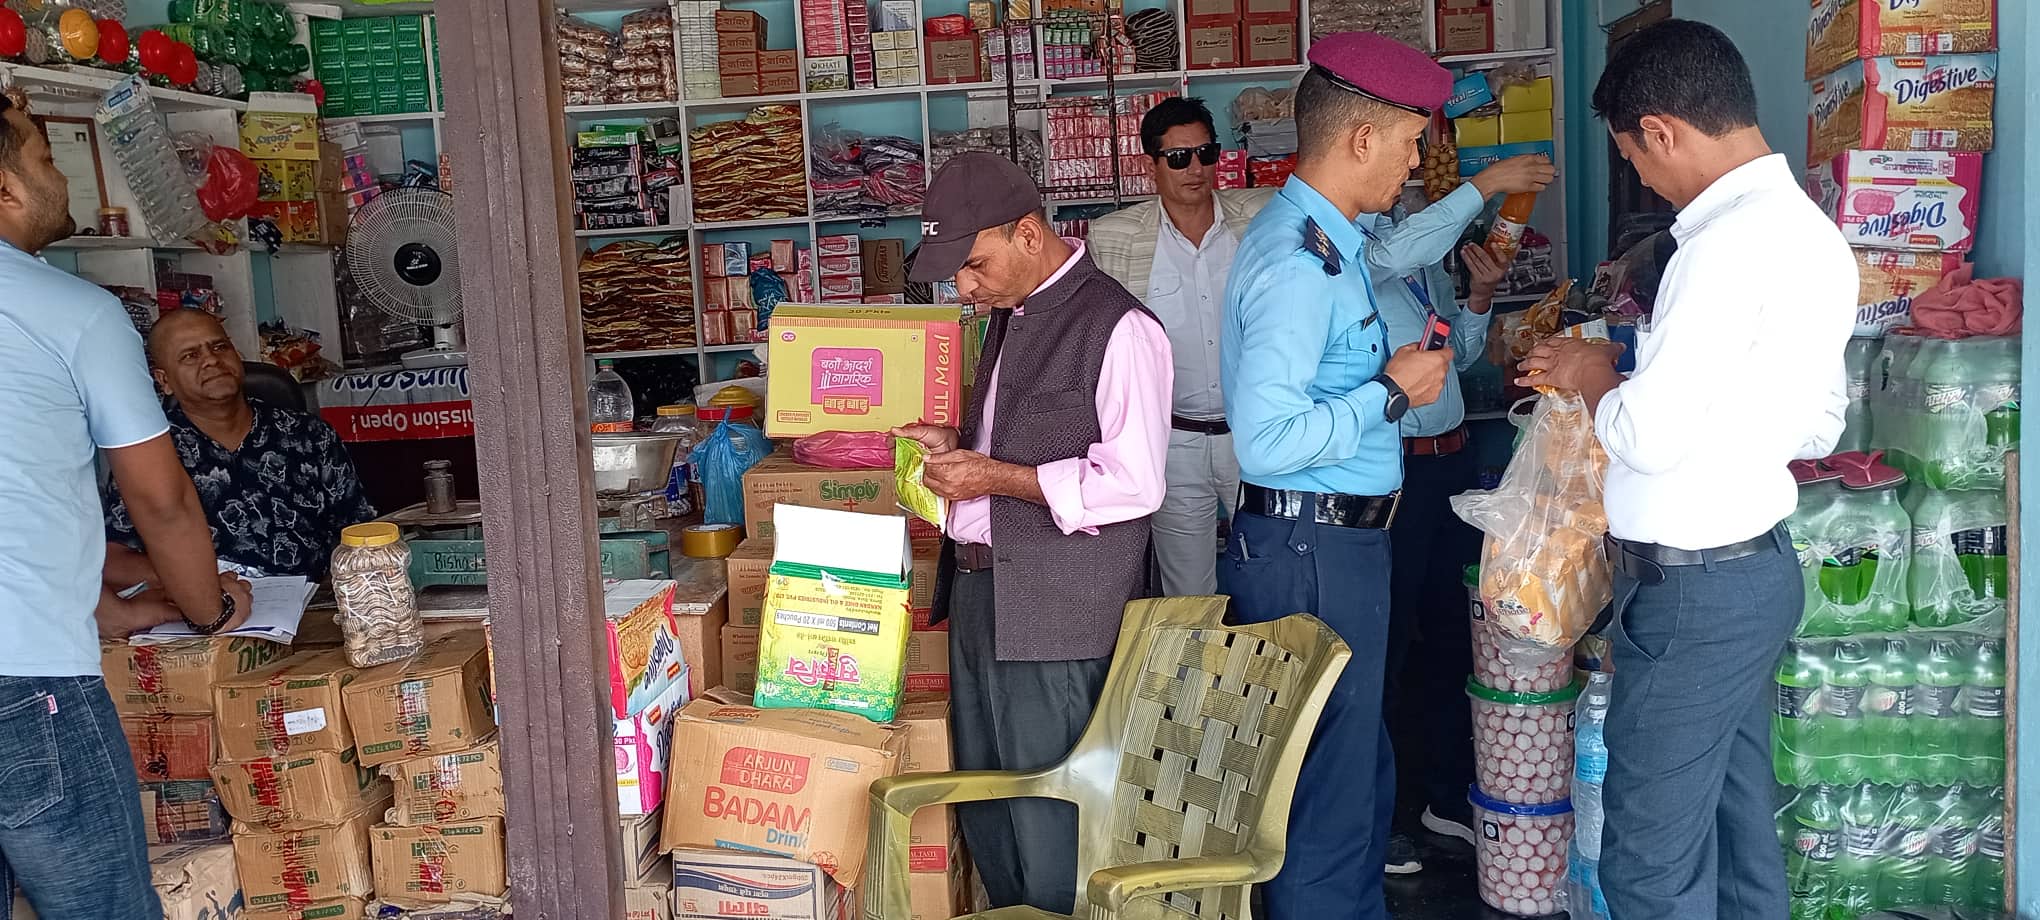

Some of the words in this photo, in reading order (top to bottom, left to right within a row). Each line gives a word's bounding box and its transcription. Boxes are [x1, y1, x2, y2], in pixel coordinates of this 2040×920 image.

[1894, 65, 1977, 105] Digestive
[1859, 201, 1947, 237] Digestive
[1856, 297, 1910, 326] igestiv
[934, 334, 950, 385] Meal
[360, 408, 407, 431] Open
[412, 410, 474, 430] ission
[934, 391, 949, 425] ULL
[819, 479, 880, 502] Simply
[839, 618, 867, 632] Contents
[867, 621, 879, 633] Net
[644, 623, 674, 690] Digestive
[744, 754, 796, 774] ARJUN
[739, 770, 793, 792] DHARA
[703, 786, 811, 833] BADAM
